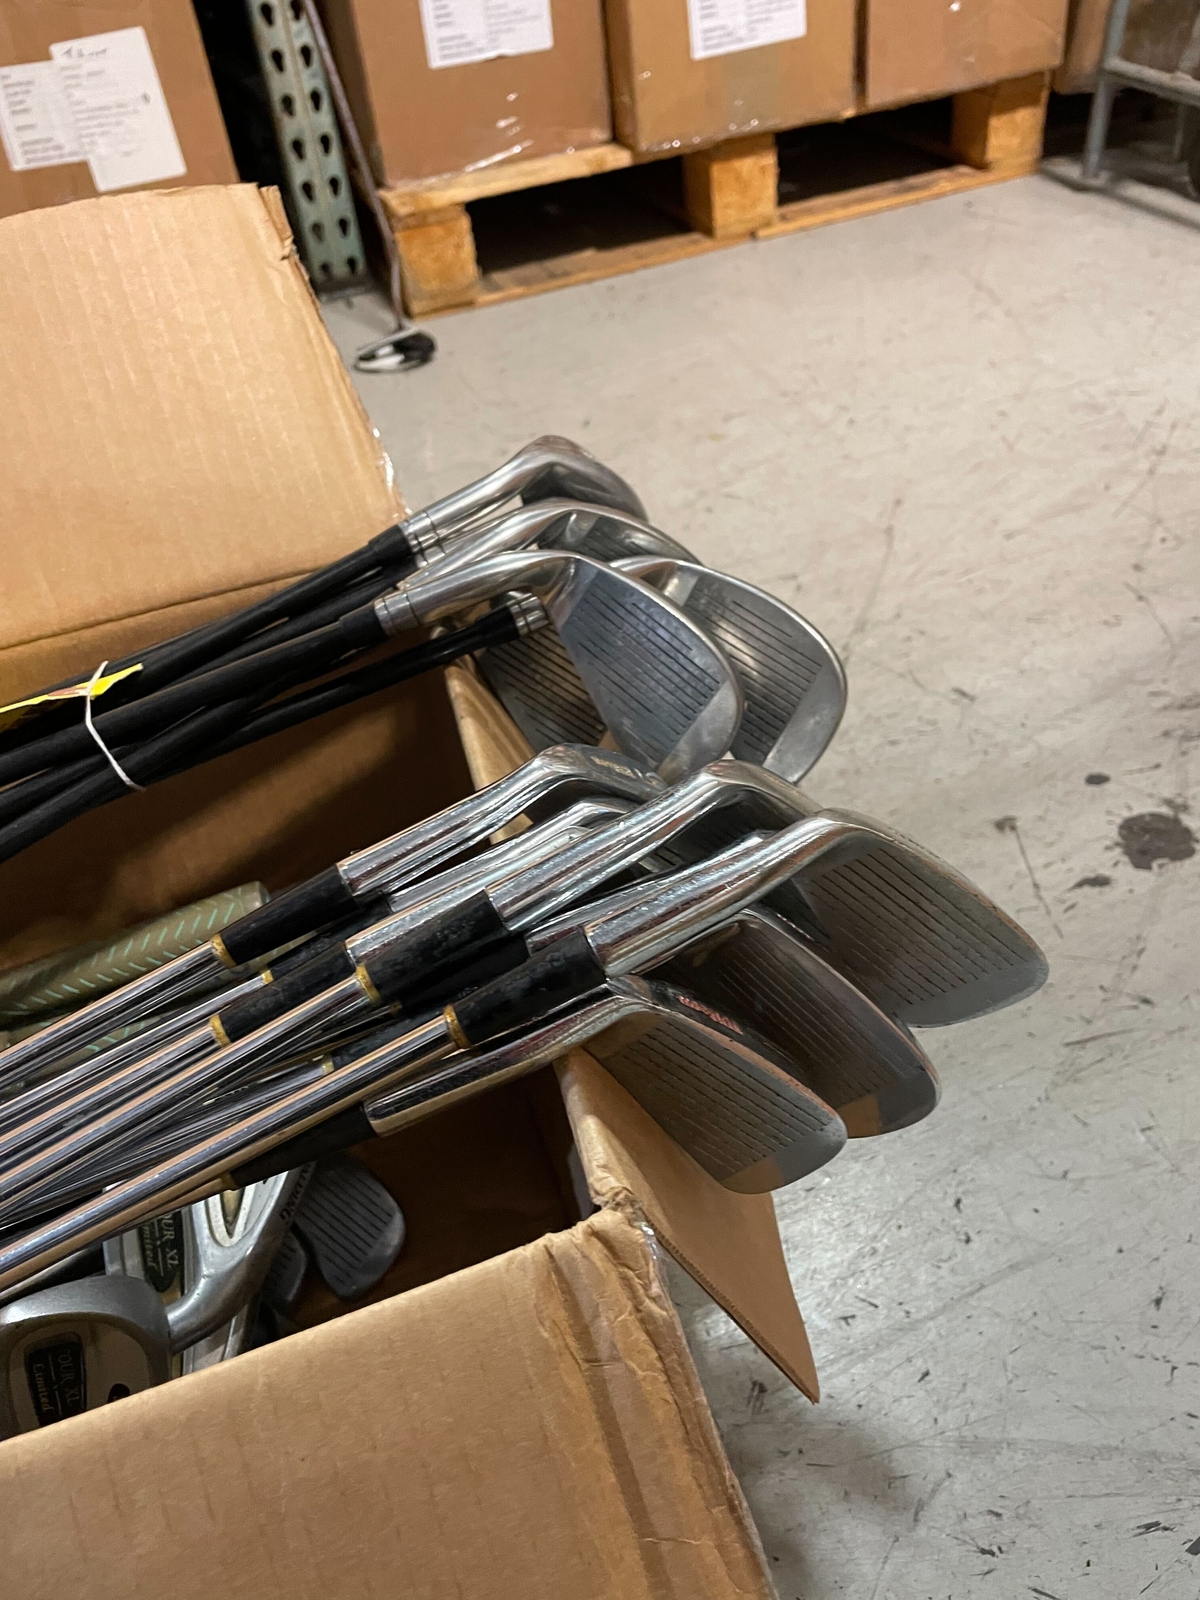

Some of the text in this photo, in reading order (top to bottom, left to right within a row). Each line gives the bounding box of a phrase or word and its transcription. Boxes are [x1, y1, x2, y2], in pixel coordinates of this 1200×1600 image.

[166, 1247, 180, 1270] XL
[33, 1363, 55, 1412] Limited
[65, 1386, 80, 1407] XL
